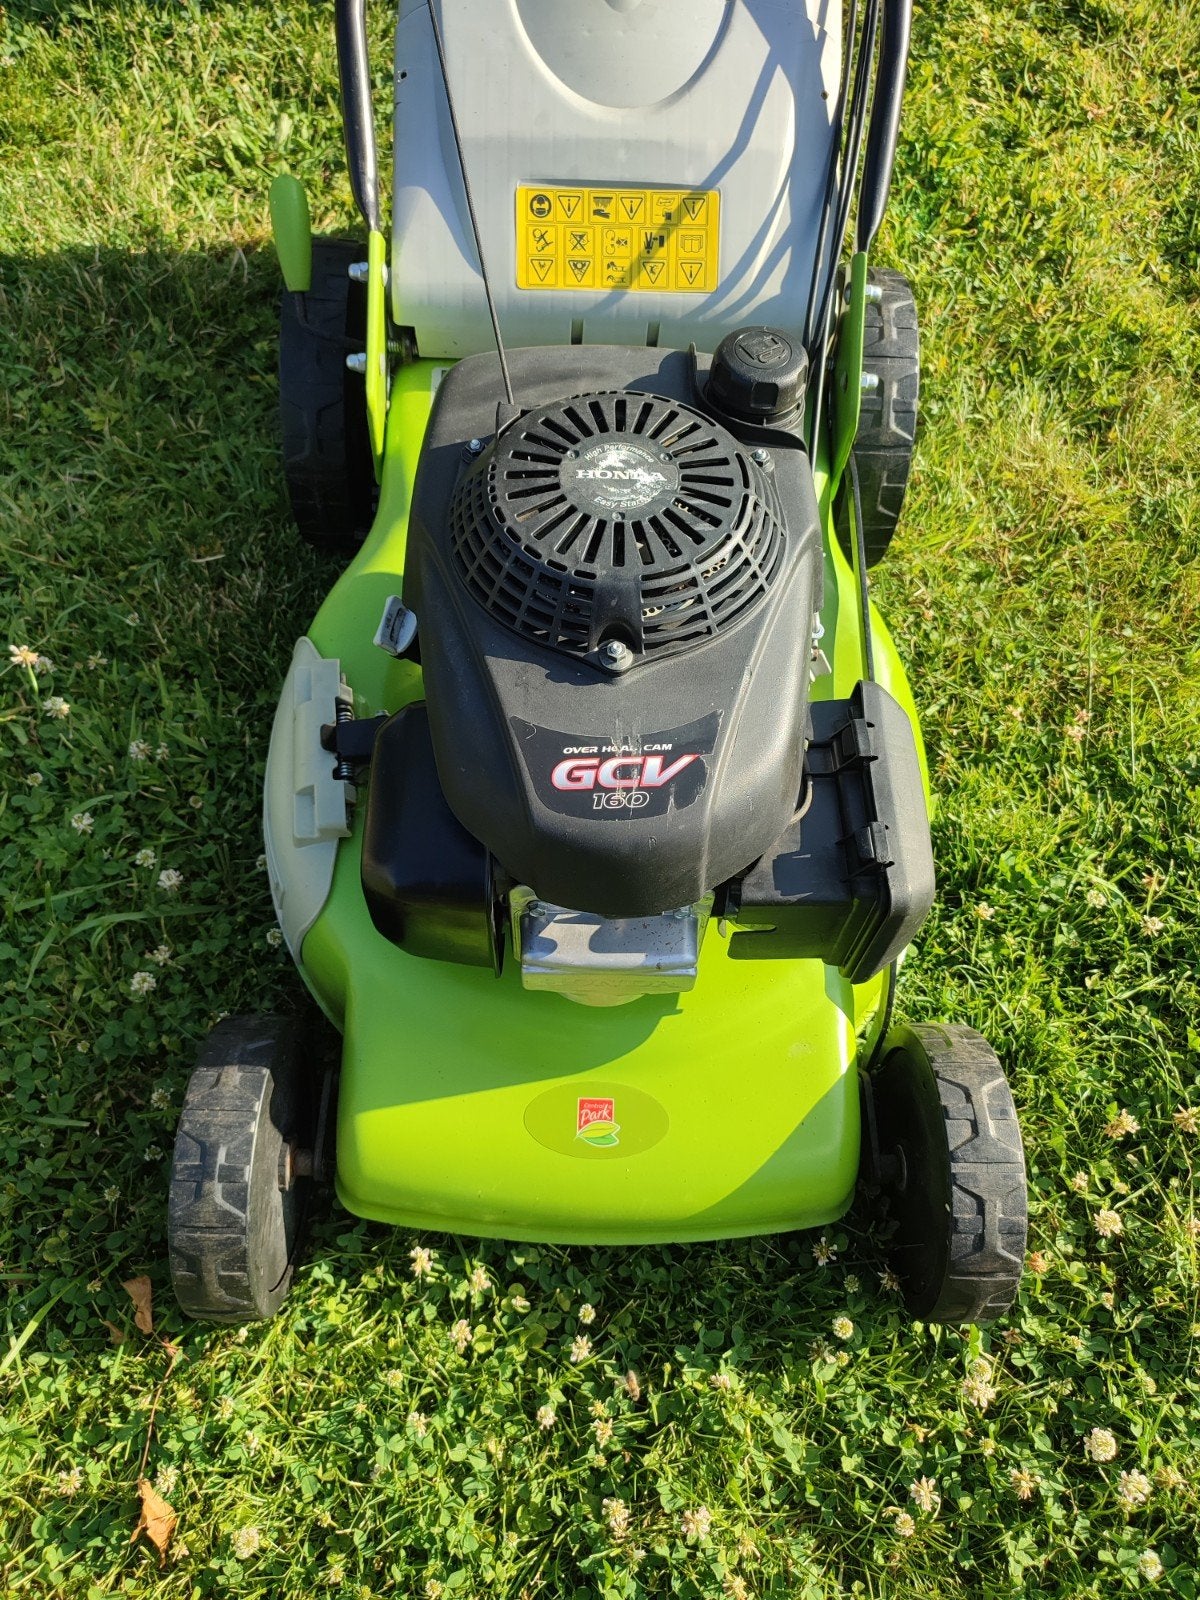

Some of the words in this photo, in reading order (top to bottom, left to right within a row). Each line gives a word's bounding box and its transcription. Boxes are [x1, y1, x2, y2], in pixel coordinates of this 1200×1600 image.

[584, 446, 603, 461] High
[604, 443, 655, 463] Performance
[594, 496, 617, 508] Easy
[563, 746, 598, 754] OVER
[643, 743, 673, 751] CAM
[551, 754, 700, 790] GCV
[593, 791, 650, 810] 160
